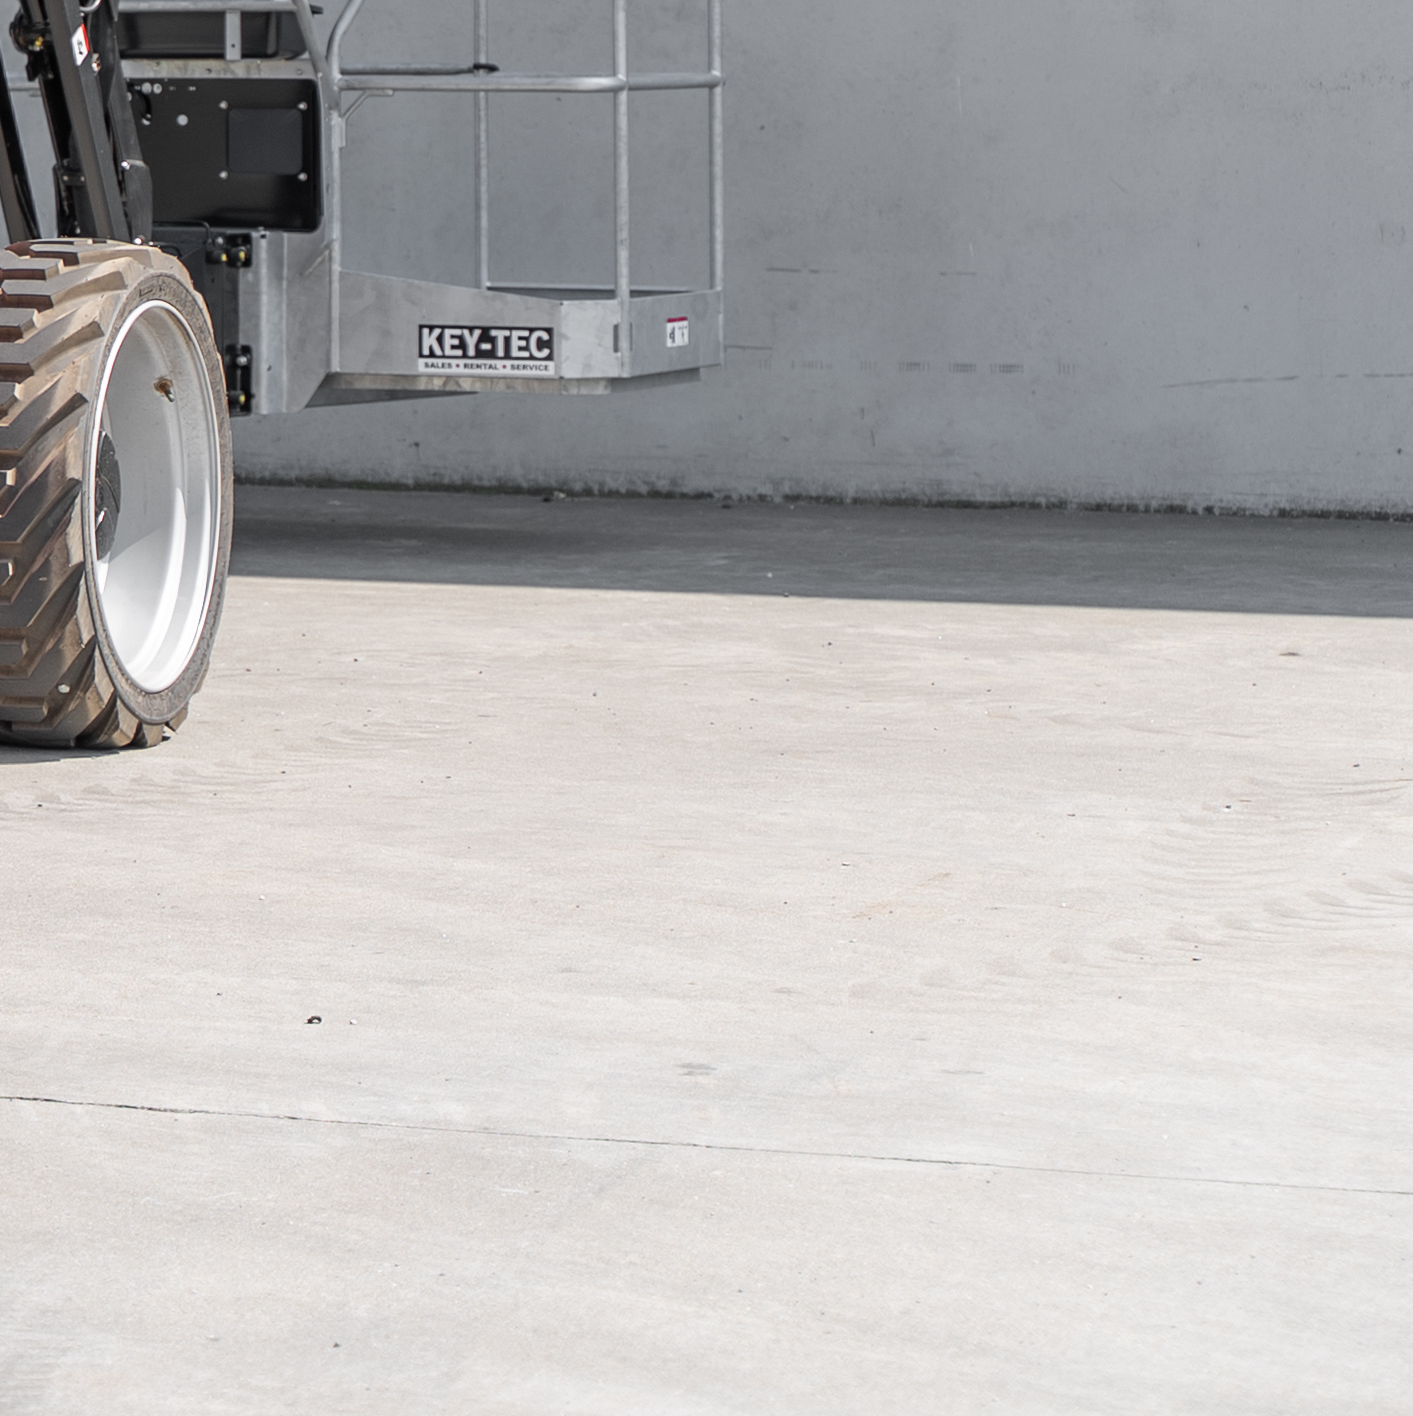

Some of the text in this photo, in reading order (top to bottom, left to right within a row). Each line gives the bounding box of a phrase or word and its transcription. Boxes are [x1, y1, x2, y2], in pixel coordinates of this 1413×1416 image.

[421, 327, 551, 359] KEY-TEC
[424, 362, 551, 372] SALES RENTAL SERVICE
